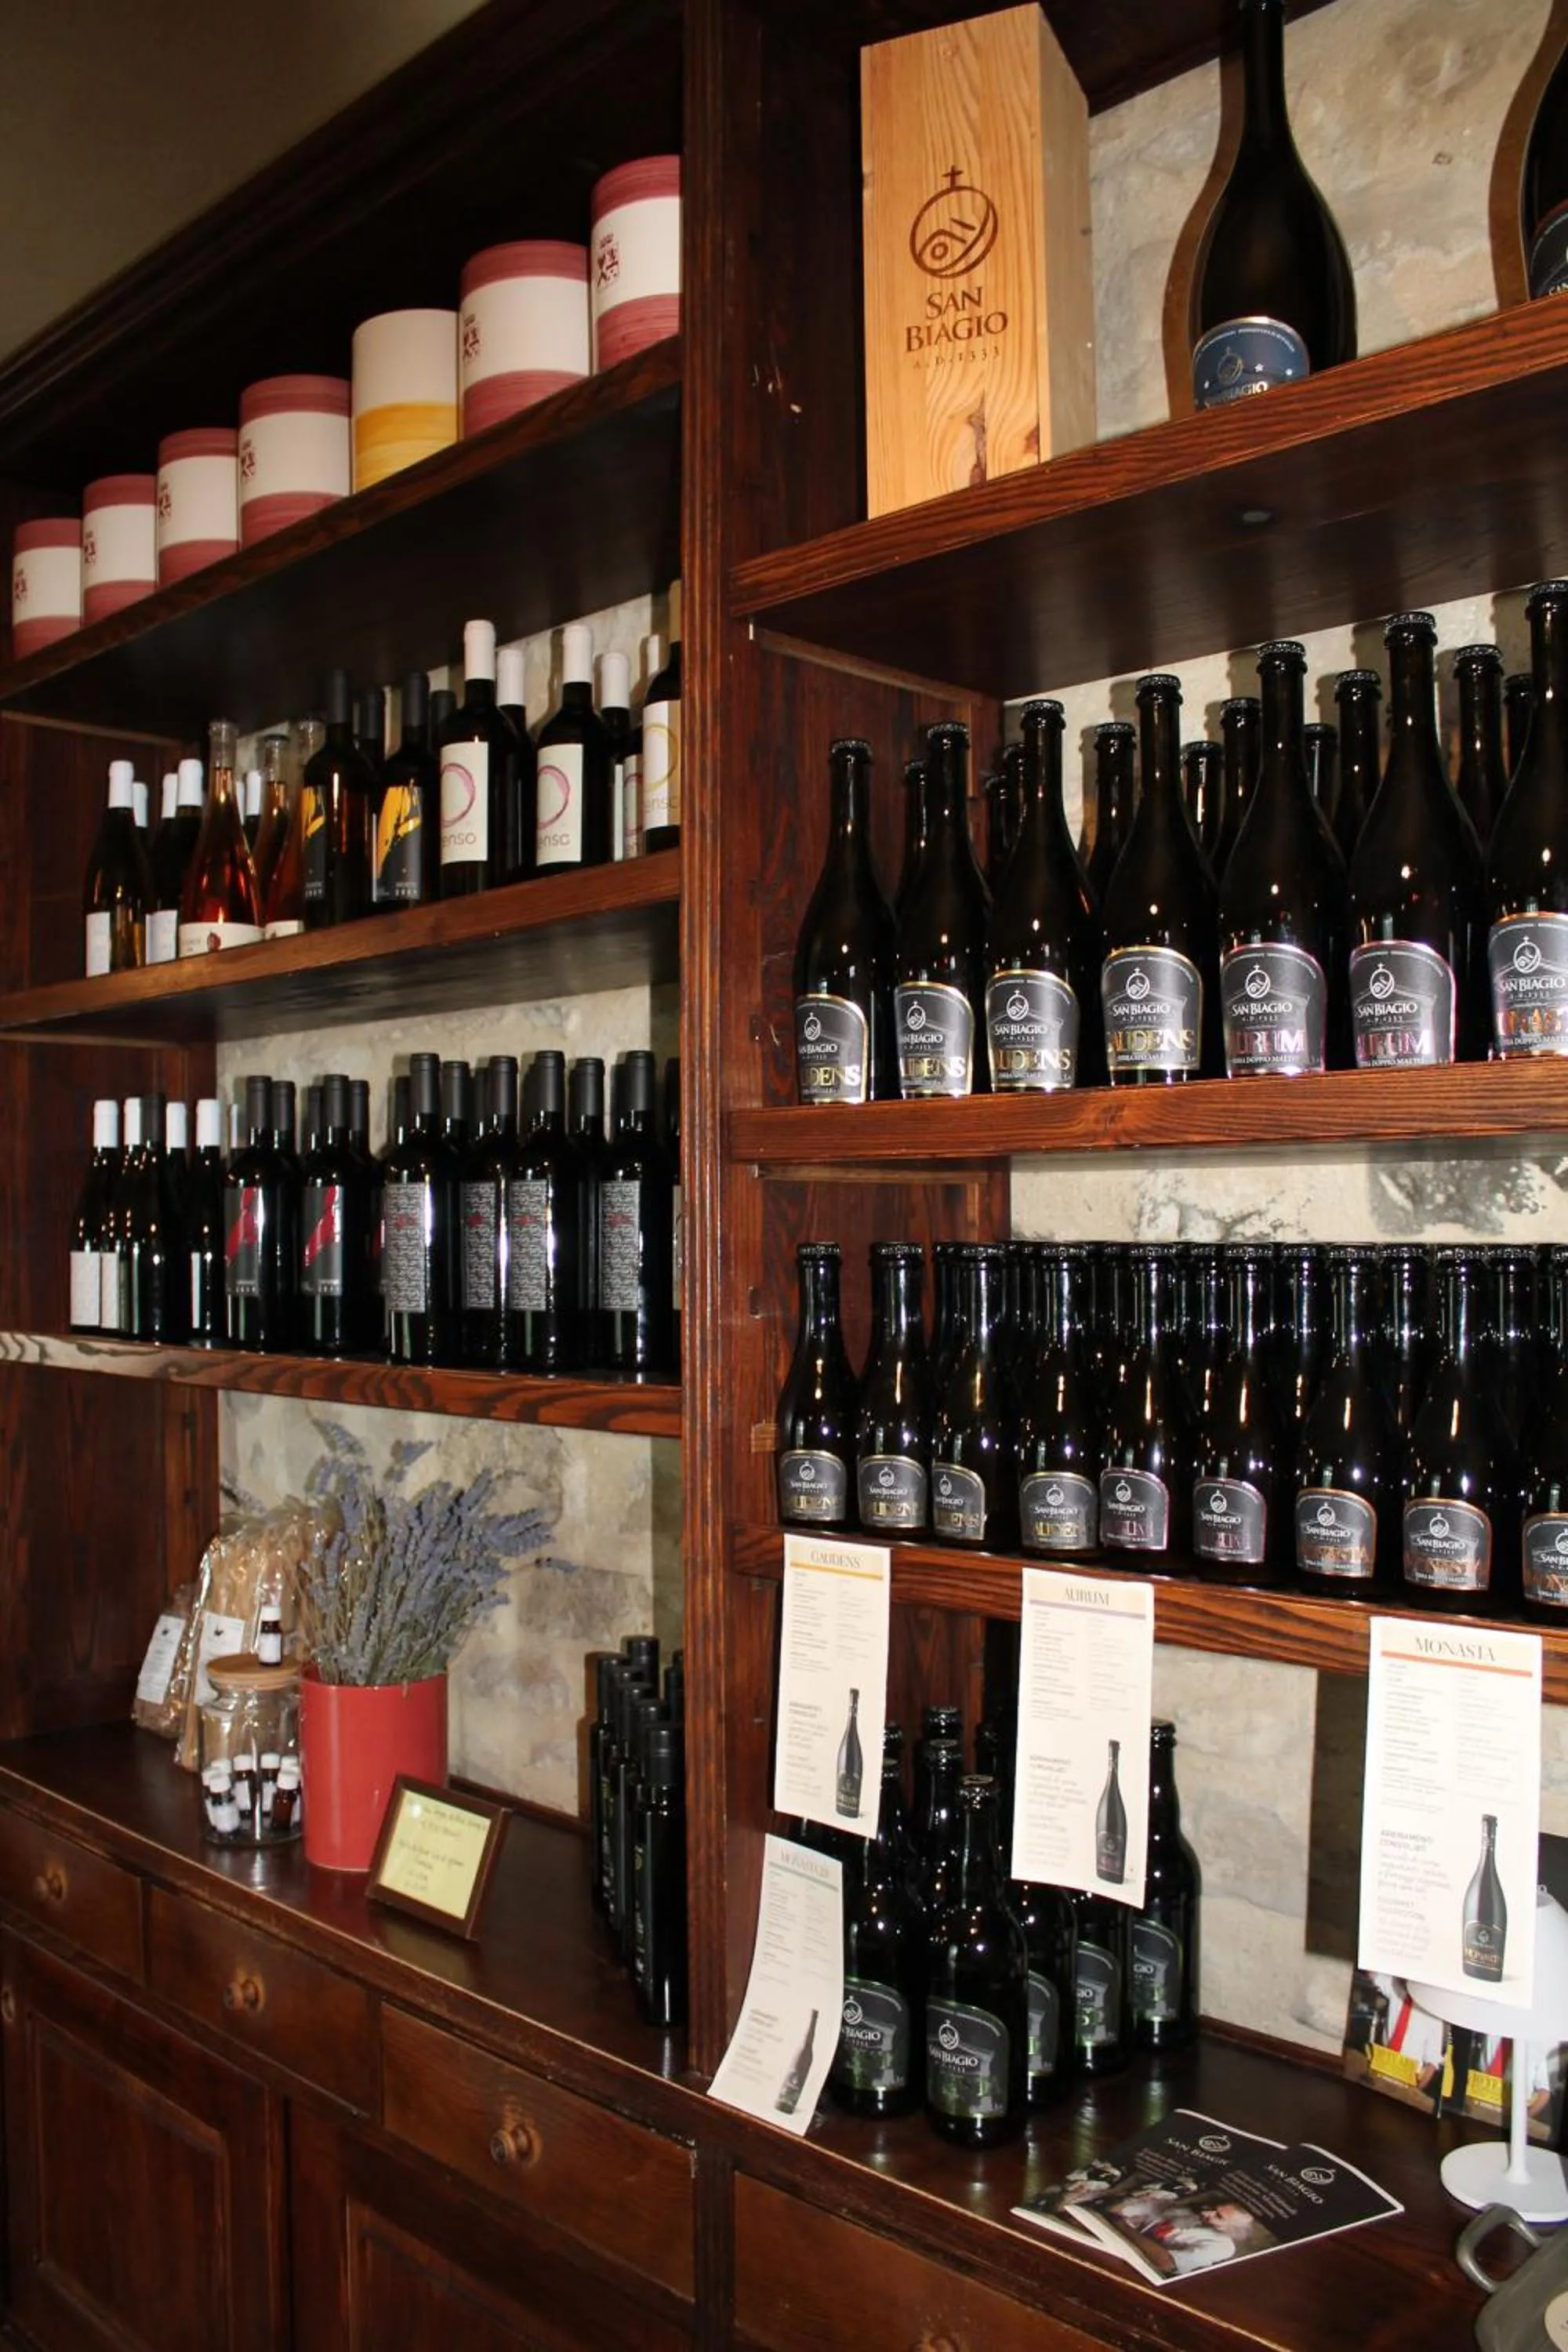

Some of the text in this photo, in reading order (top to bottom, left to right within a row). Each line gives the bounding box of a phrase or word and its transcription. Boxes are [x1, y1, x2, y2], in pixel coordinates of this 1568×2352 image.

[926, 287, 982, 320] SAN
[906, 311, 1009, 353] BIAGIO
[1519, 977, 1565, 992] BIAGIO
[1131, 1003, 1171, 1015] BIAGIO
[1250, 1002, 1293, 1015] BIAGIO
[1374, 1002, 1417, 1016] BIAGIO
[1011, 1022, 1048, 1035] BIAGIO
[1415, 1635, 1497, 1662] MONASTA
[942, 2050, 978, 2067] BIAGIO
